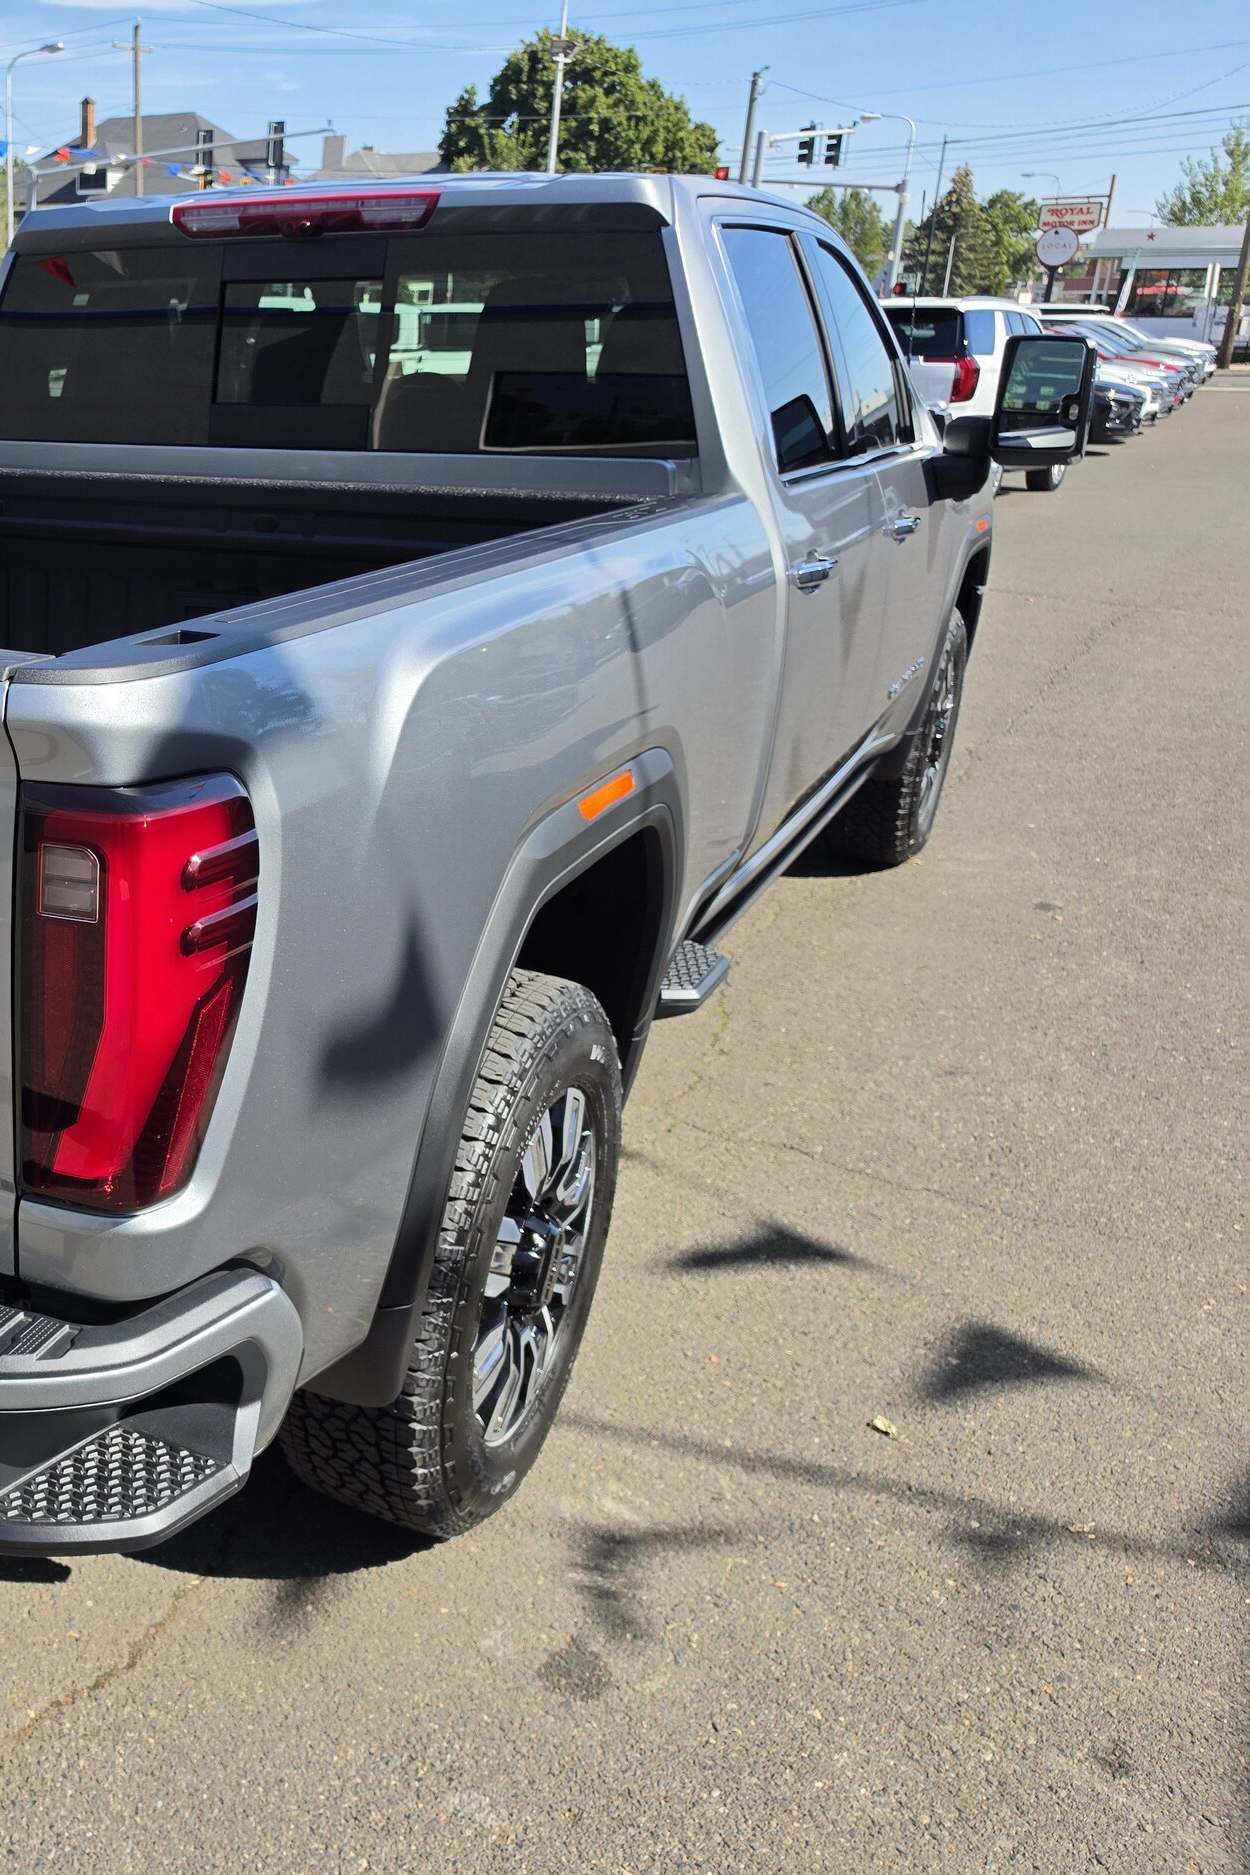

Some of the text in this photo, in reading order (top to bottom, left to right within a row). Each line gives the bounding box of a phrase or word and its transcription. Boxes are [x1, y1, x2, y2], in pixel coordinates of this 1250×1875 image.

[1047, 206, 1093, 219] ROYAL
[1042, 220, 1075, 229] MOTOR
[1042, 242, 1072, 250] LOCAL
